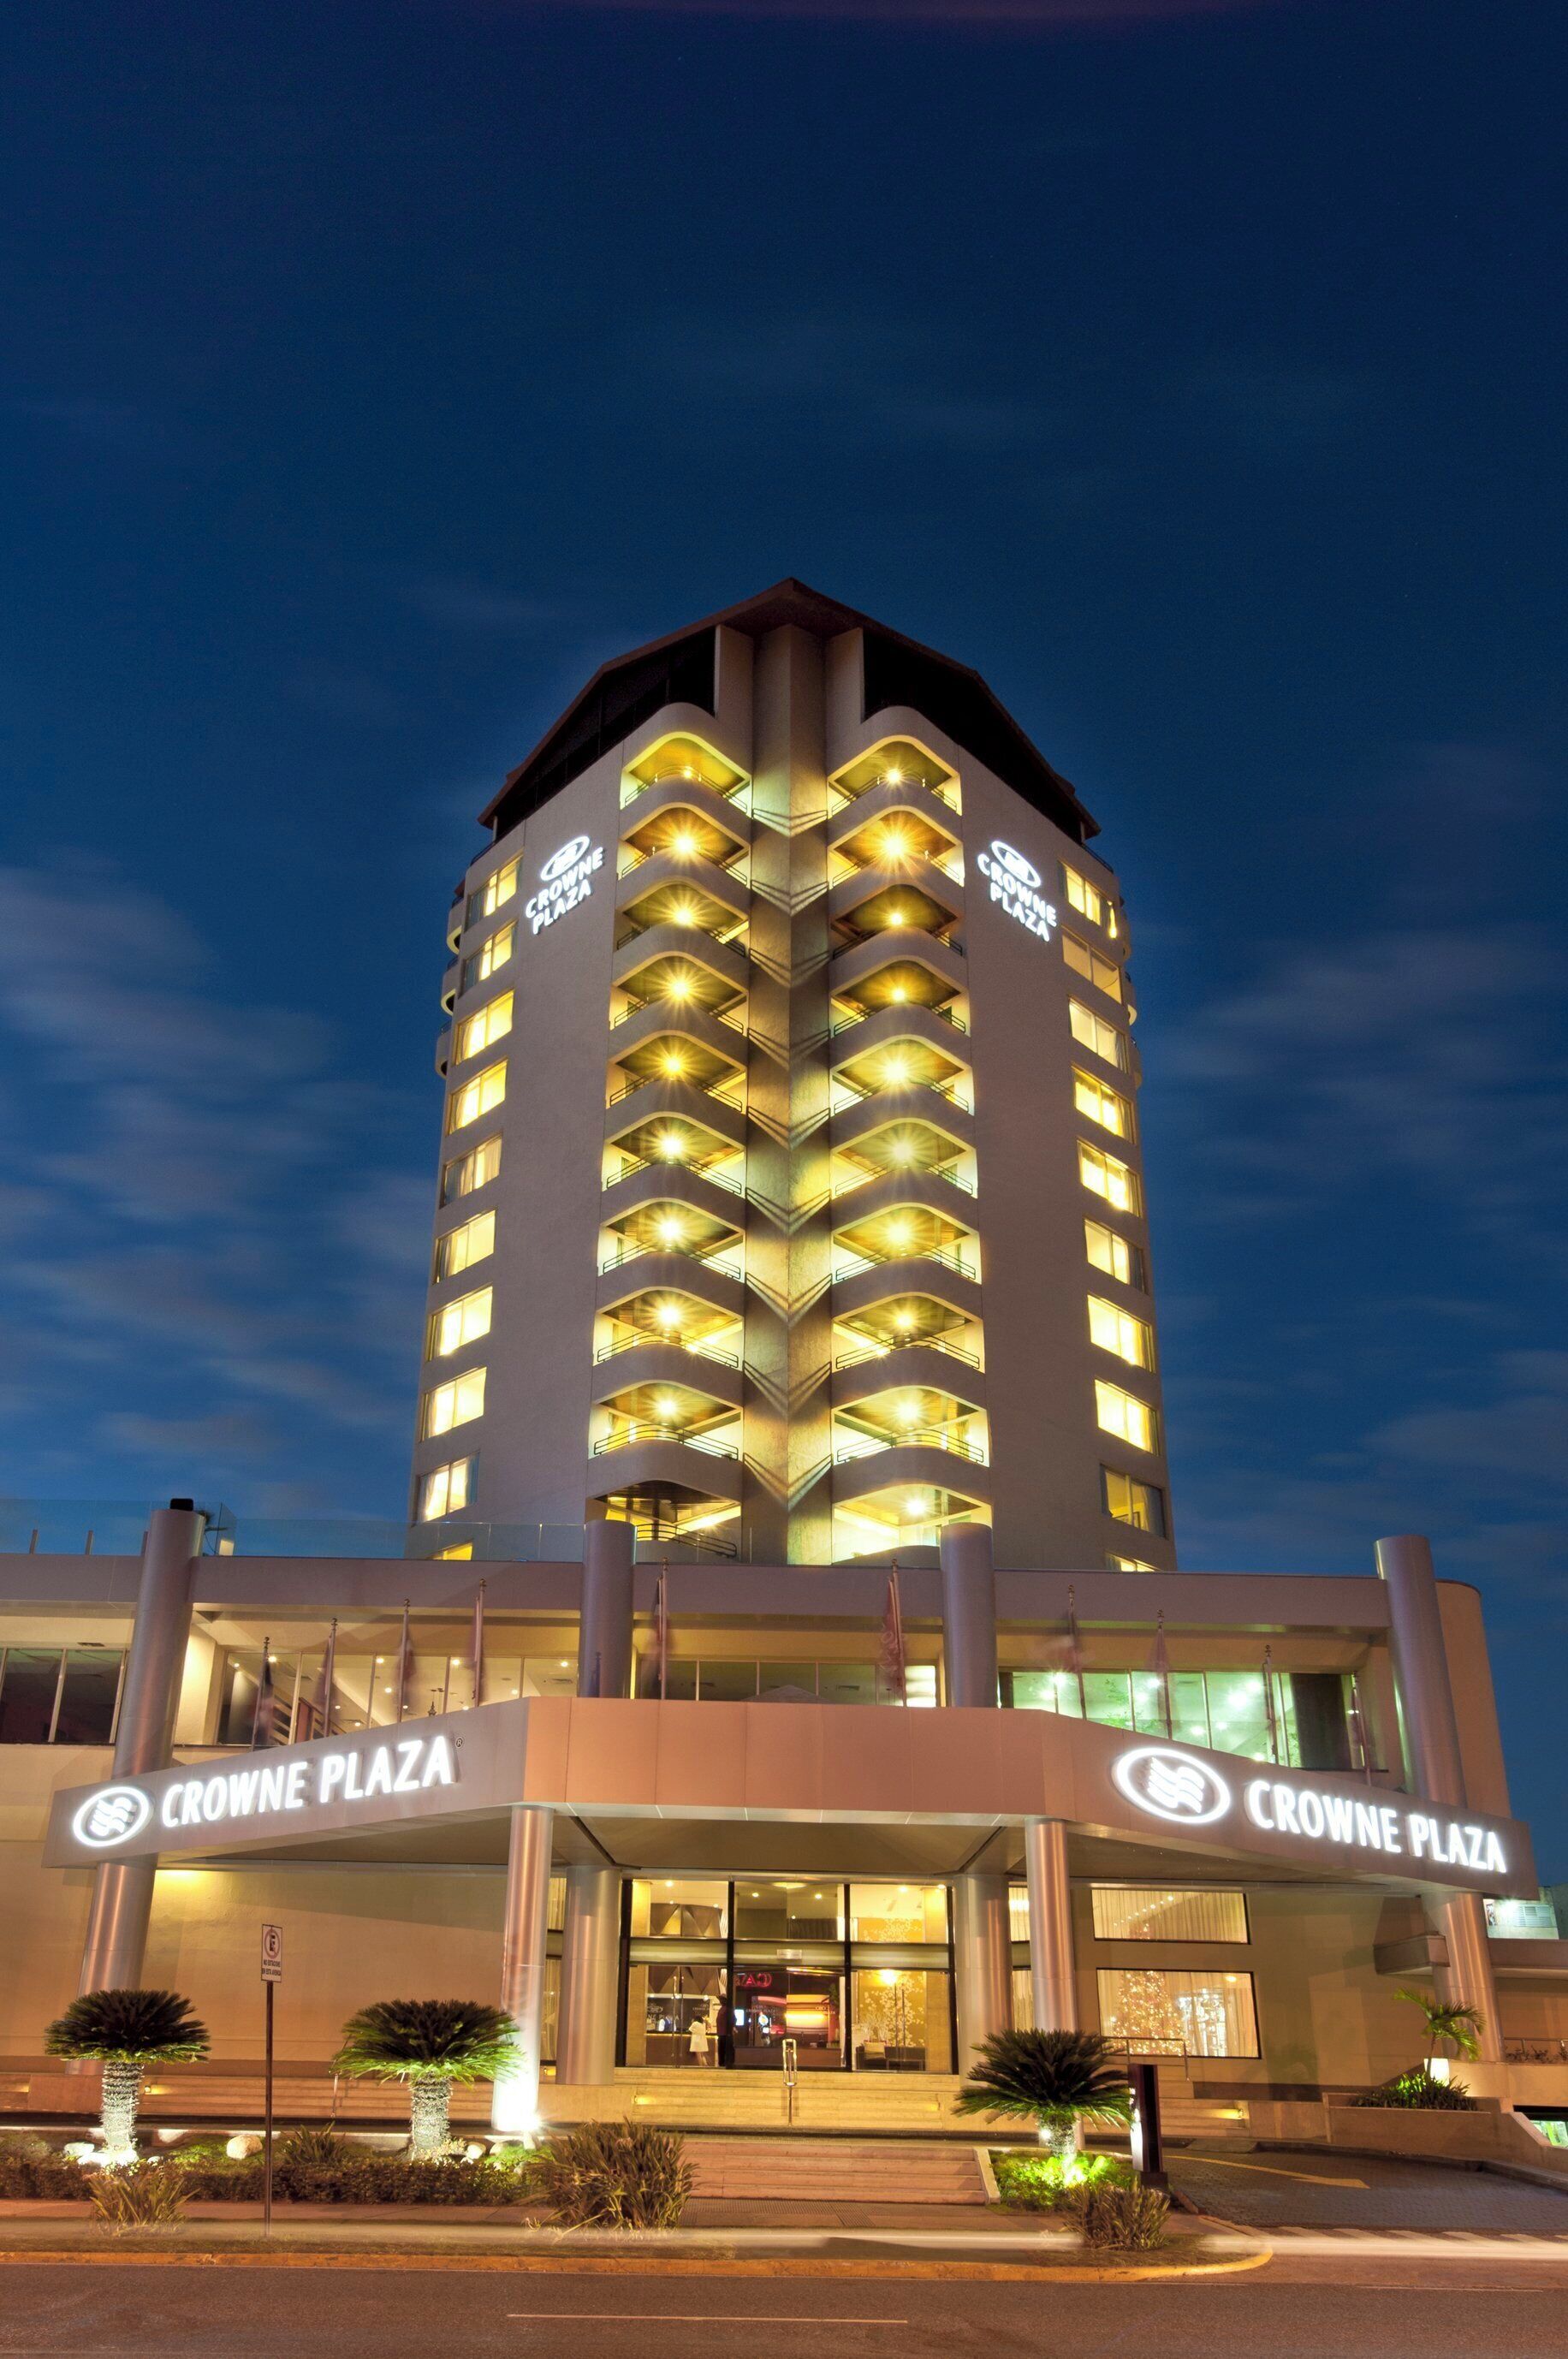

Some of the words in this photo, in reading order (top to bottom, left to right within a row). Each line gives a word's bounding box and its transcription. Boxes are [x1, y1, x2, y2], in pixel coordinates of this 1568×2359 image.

[525, 847, 603, 918] CROWNE
[532, 878, 591, 935] PLAZA
[977, 853, 1057, 927] CROWNE
[990, 882, 1050, 942] PLAZA
[161, 1761, 308, 1828] CROWNE
[319, 1735, 455, 1803] PLAZA
[1248, 1780, 1402, 1853] CROWNE
[1409, 1814, 1507, 1874] PLAZA
